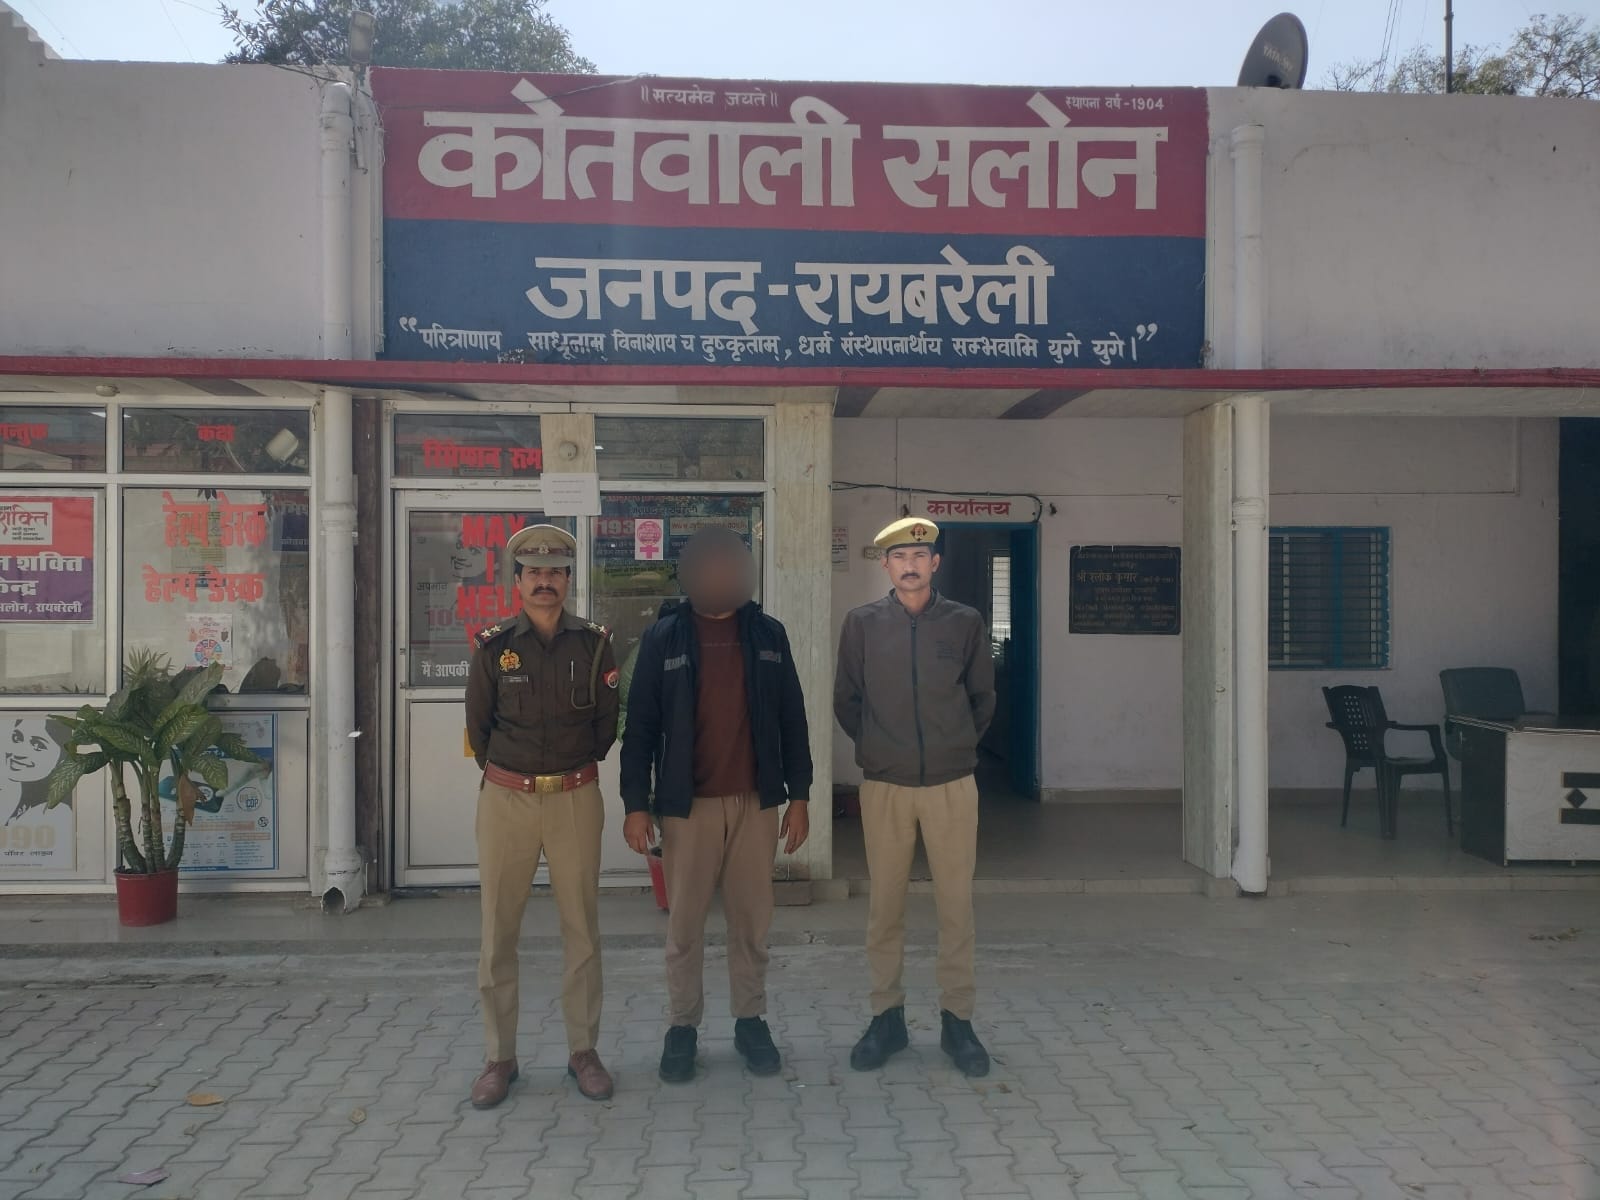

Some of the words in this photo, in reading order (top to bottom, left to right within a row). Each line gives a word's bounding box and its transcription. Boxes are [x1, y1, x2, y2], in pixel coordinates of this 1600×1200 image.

[1065, 95, 1101, 110] स्थापना
[417, 77, 861, 208] कोतवाली
[882, 91, 1169, 210] सलोन
[611, 328, 677, 352] विनाशाय
[680, 333, 695, 350] च
[798, 329, 833, 358] धर्म
[840, 329, 942, 357] संस्थापनार्थाय
[952, 333, 1039, 359] सम्भवामि
[1047, 331, 1082, 364] युगे
[461, 515, 527, 548] MAY
[598, 519, 635, 536] 193
[16, 551, 84, 572] शक्ति
[486, 549, 494, 583] I
[36, 600, 83, 614] रायबरेली
[456, 585, 524, 619] HELP
[435, 659, 471, 677] आपकी
